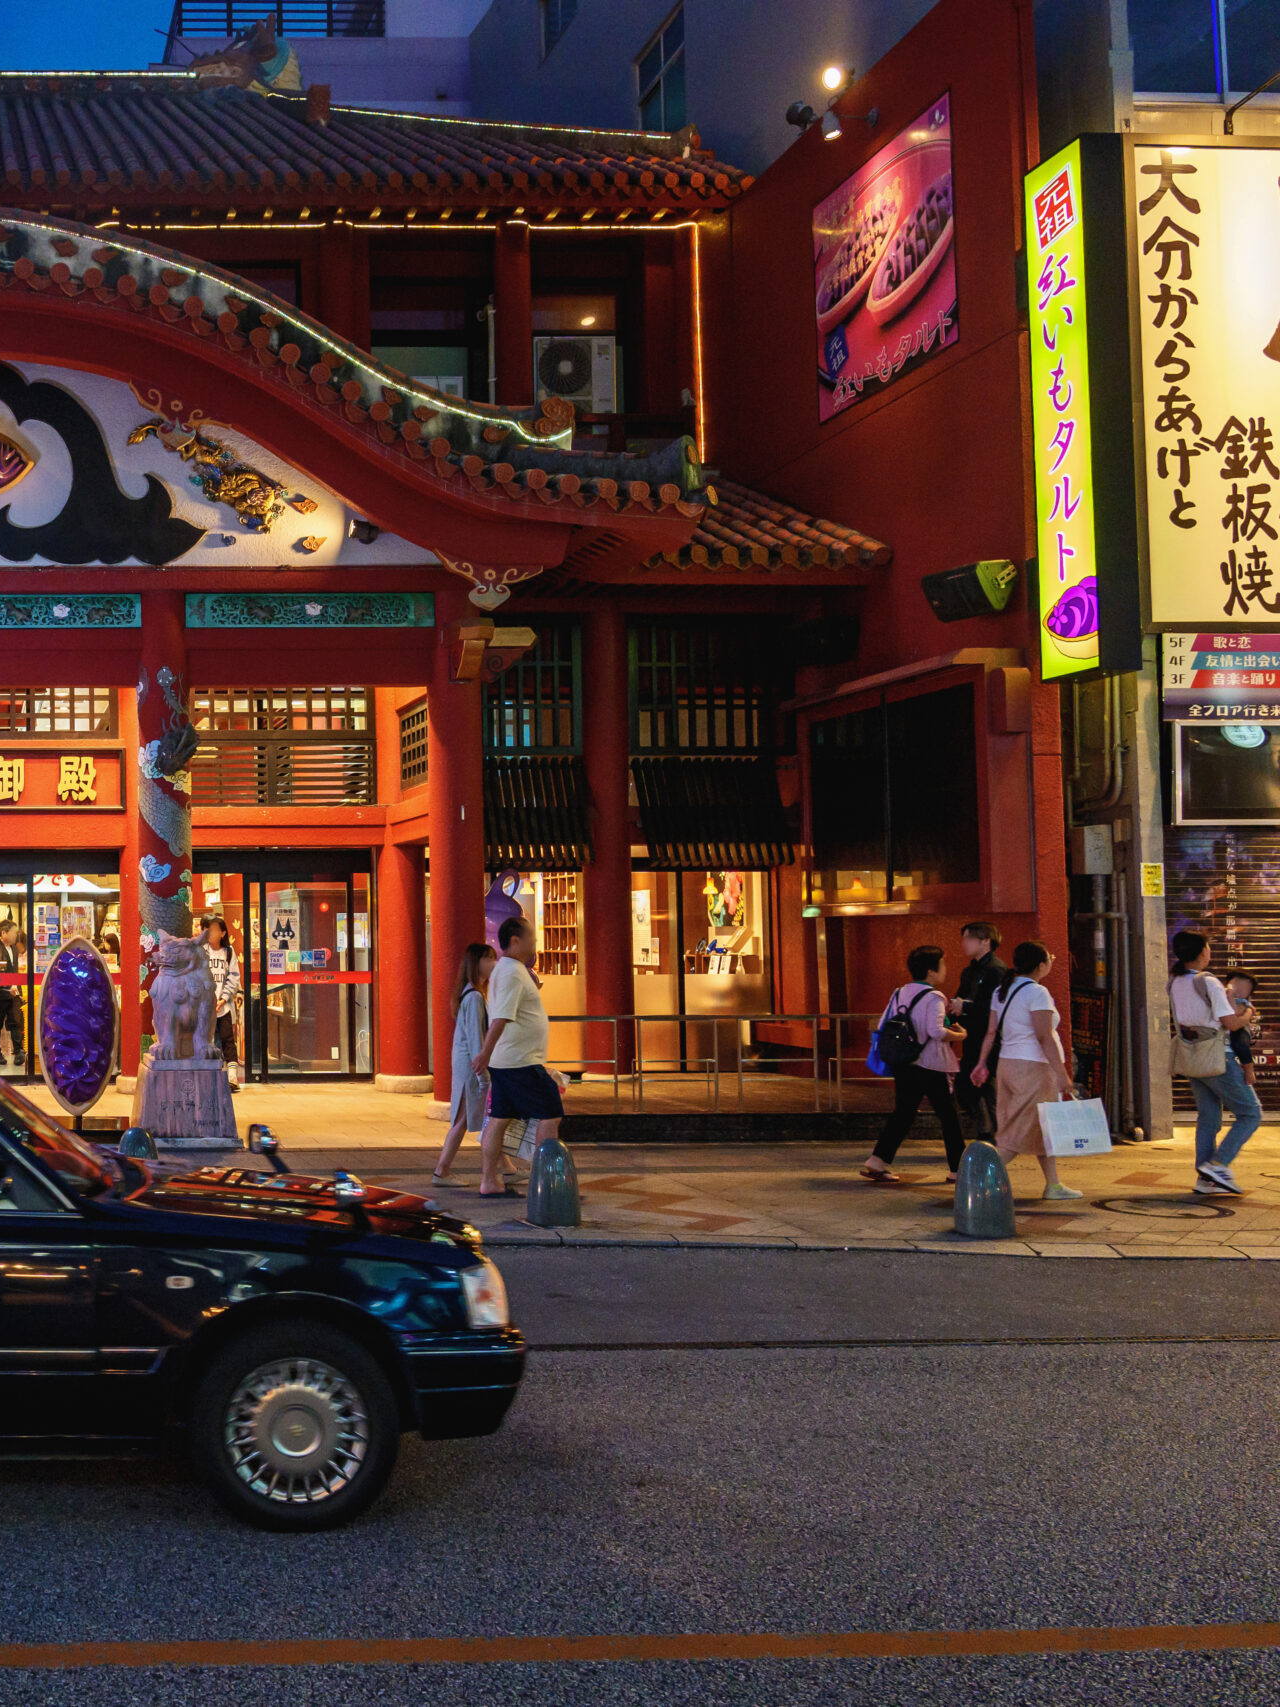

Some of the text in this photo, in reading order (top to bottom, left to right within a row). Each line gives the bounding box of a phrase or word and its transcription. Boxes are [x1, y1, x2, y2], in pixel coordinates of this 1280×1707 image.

[1039, 178, 1075, 242] 元祖
[832, 310, 953, 412] 紅いもタルト
[1139, 150, 1210, 530] 大分からあげと
[1037, 254, 1084, 583] 紅いもタルト
[1168, 655, 1187, 667] 4F
[1169, 635, 1252, 649] 5F 歌と恋
[1169, 672, 1276, 686] 3F 音楽と踊り
